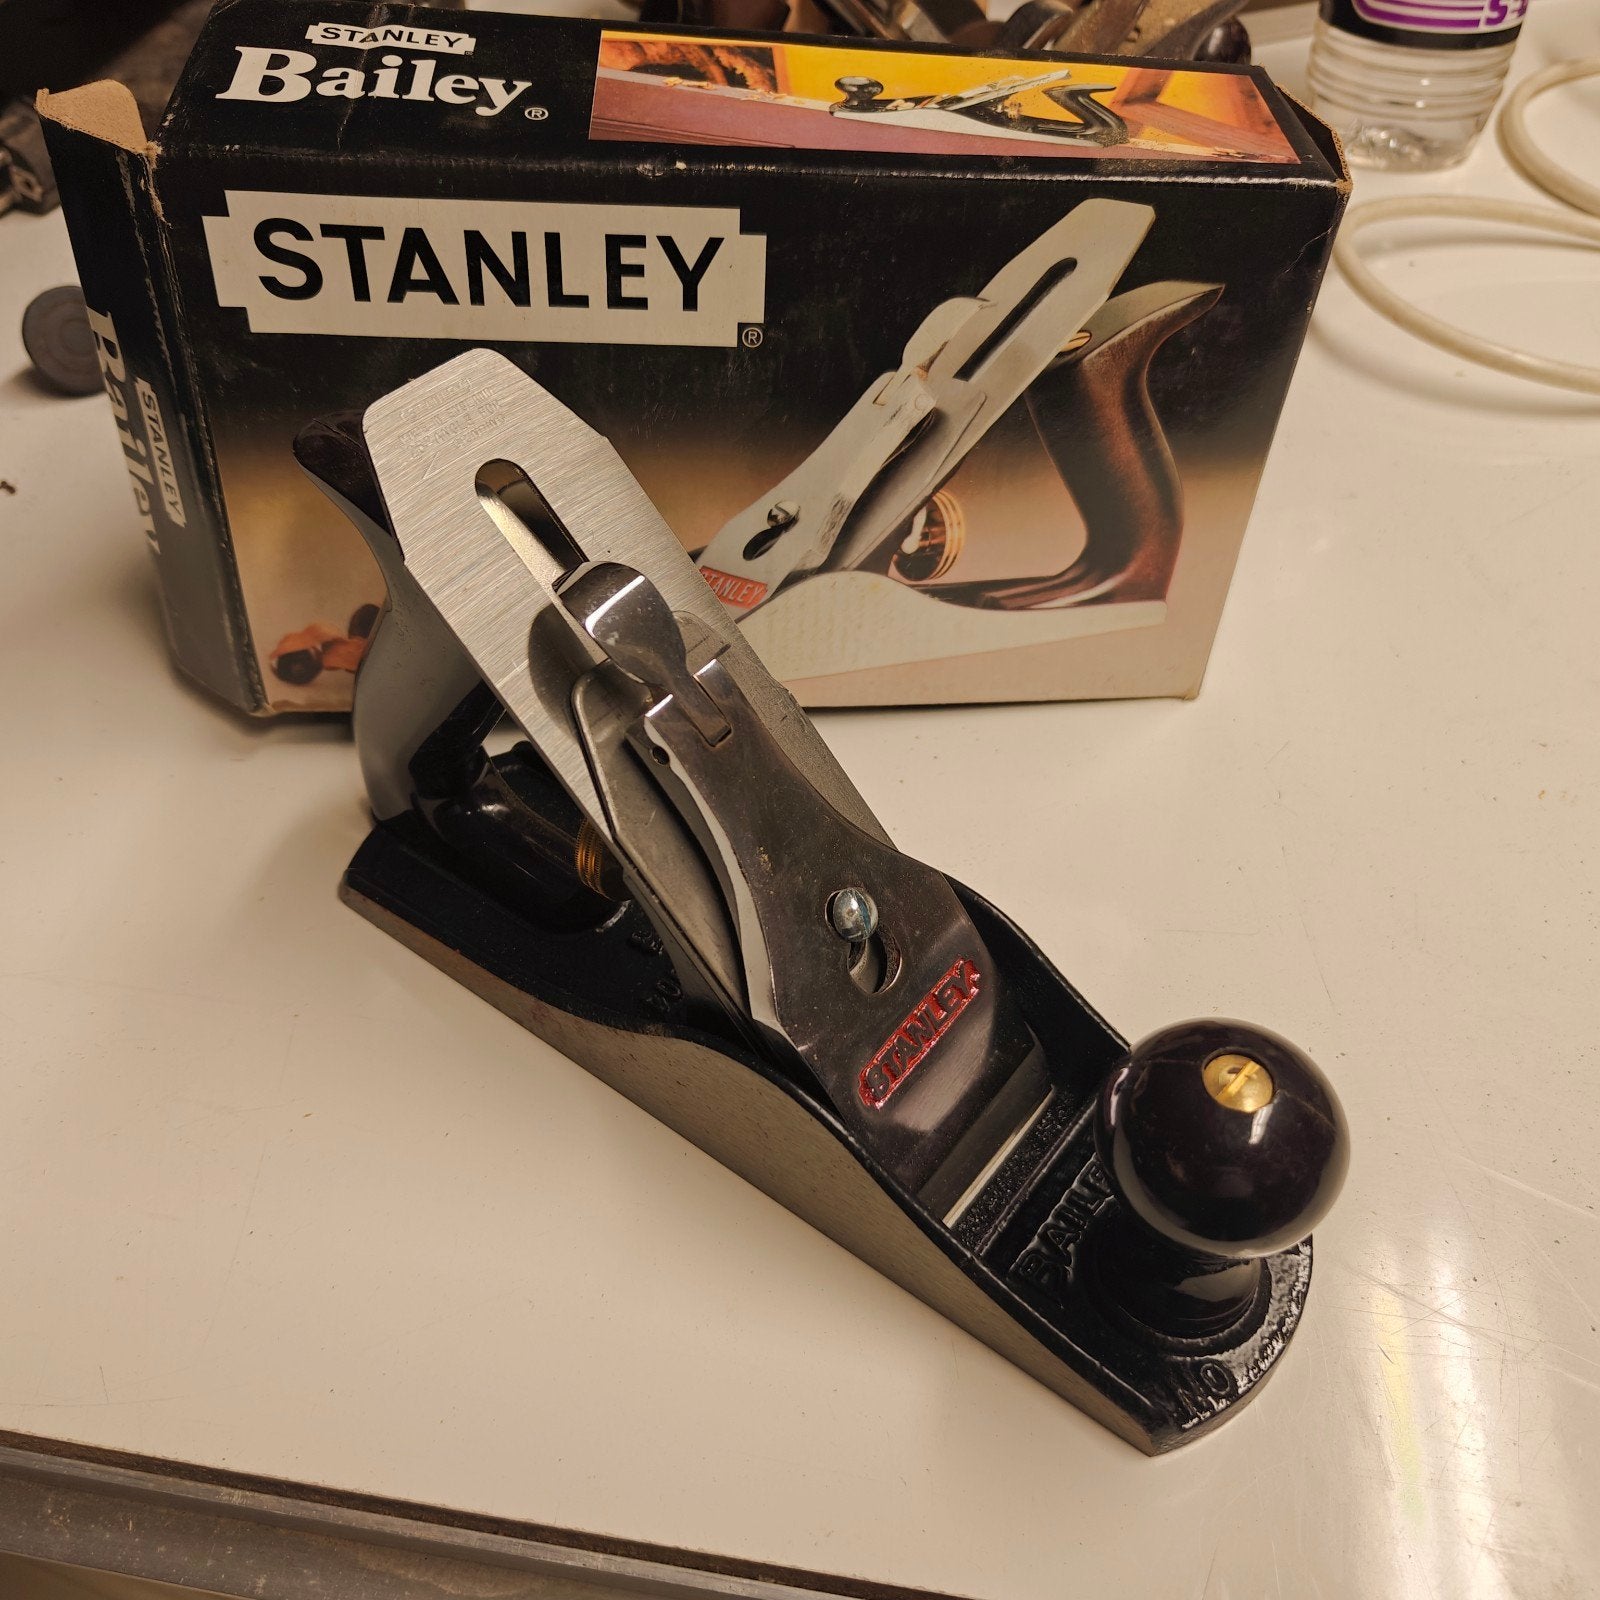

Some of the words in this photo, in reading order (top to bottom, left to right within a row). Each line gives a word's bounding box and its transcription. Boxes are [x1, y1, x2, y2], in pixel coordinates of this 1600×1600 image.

[310, 27, 463, 48] STANLEY
[215, 45, 533, 117] Bailey
[252, 216, 725, 312] STANLEY
[141, 390, 185, 516] STANLEY
[700, 572, 762, 603] TANLEY
[859, 959, 981, 1109] STANLEY
